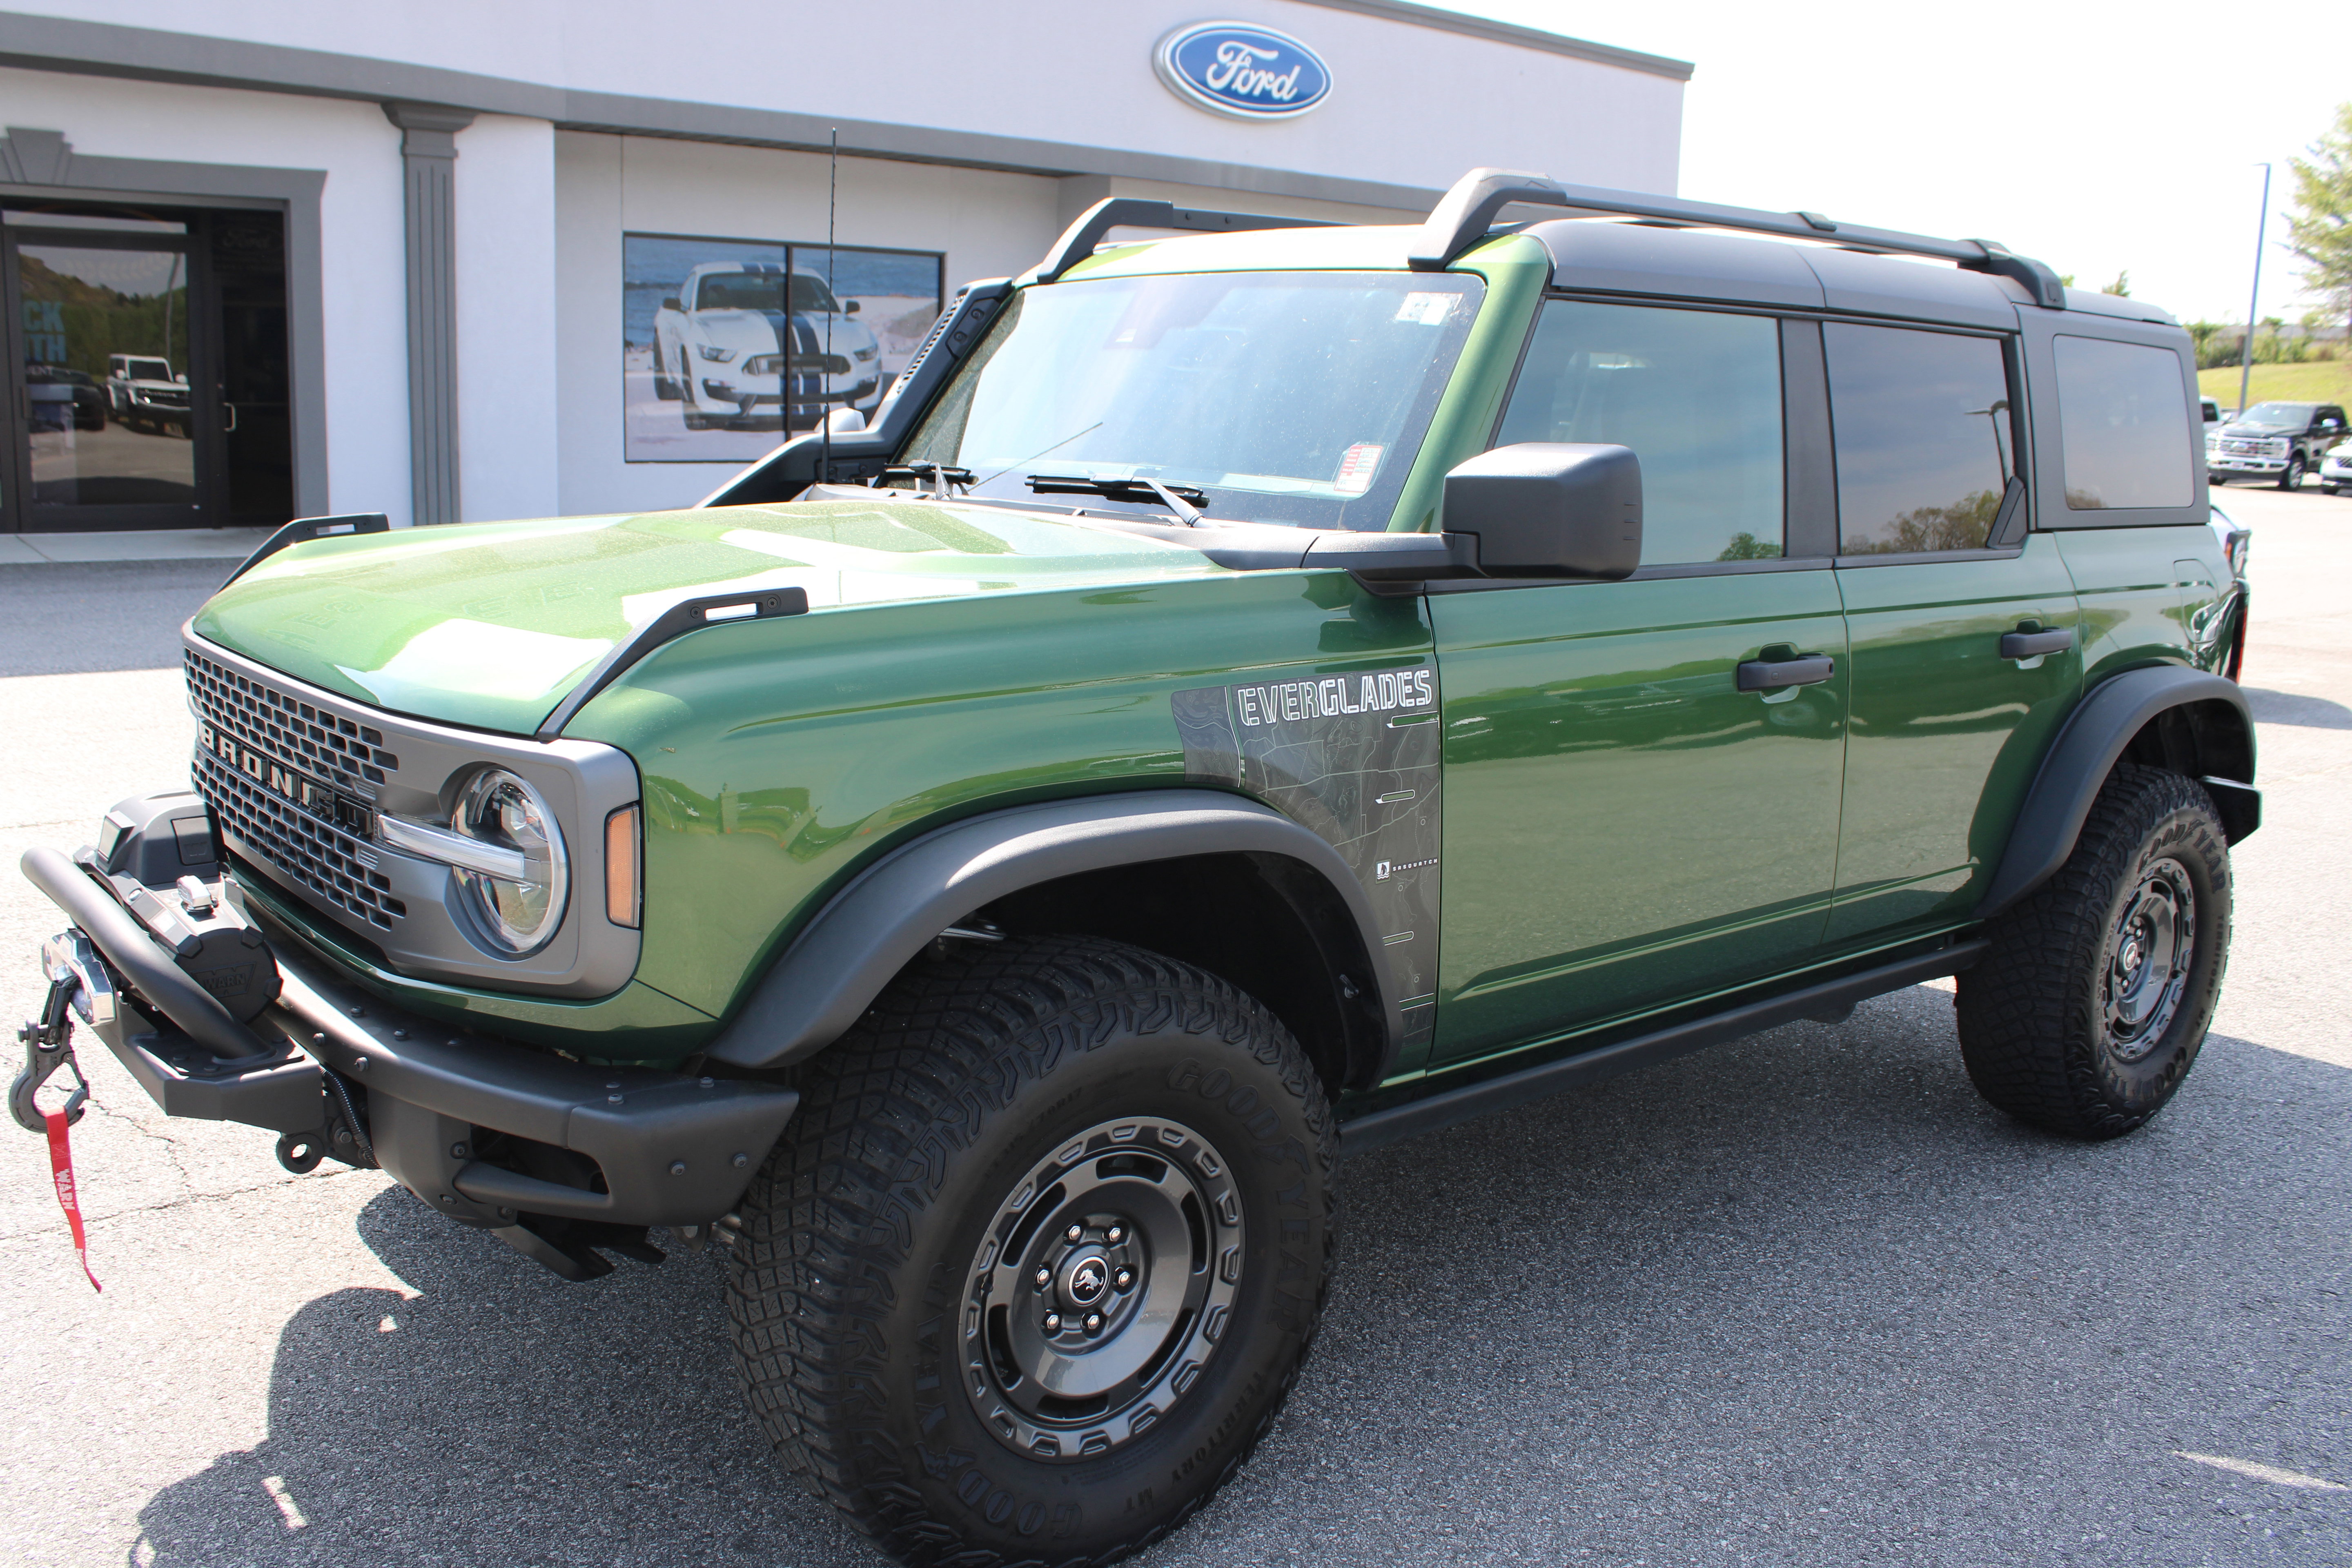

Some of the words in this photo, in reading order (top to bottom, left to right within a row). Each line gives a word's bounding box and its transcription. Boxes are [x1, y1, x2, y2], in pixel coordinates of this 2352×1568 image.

[1206, 40, 1301, 101] Ford
[1238, 669, 1433, 726] EVERGLADES
[199, 719, 374, 835] BRONCO
[1392, 858, 1437, 871] SASQUATCH
[203, 973, 247, 990] WARN
[55, 1168, 76, 1210] WARN
